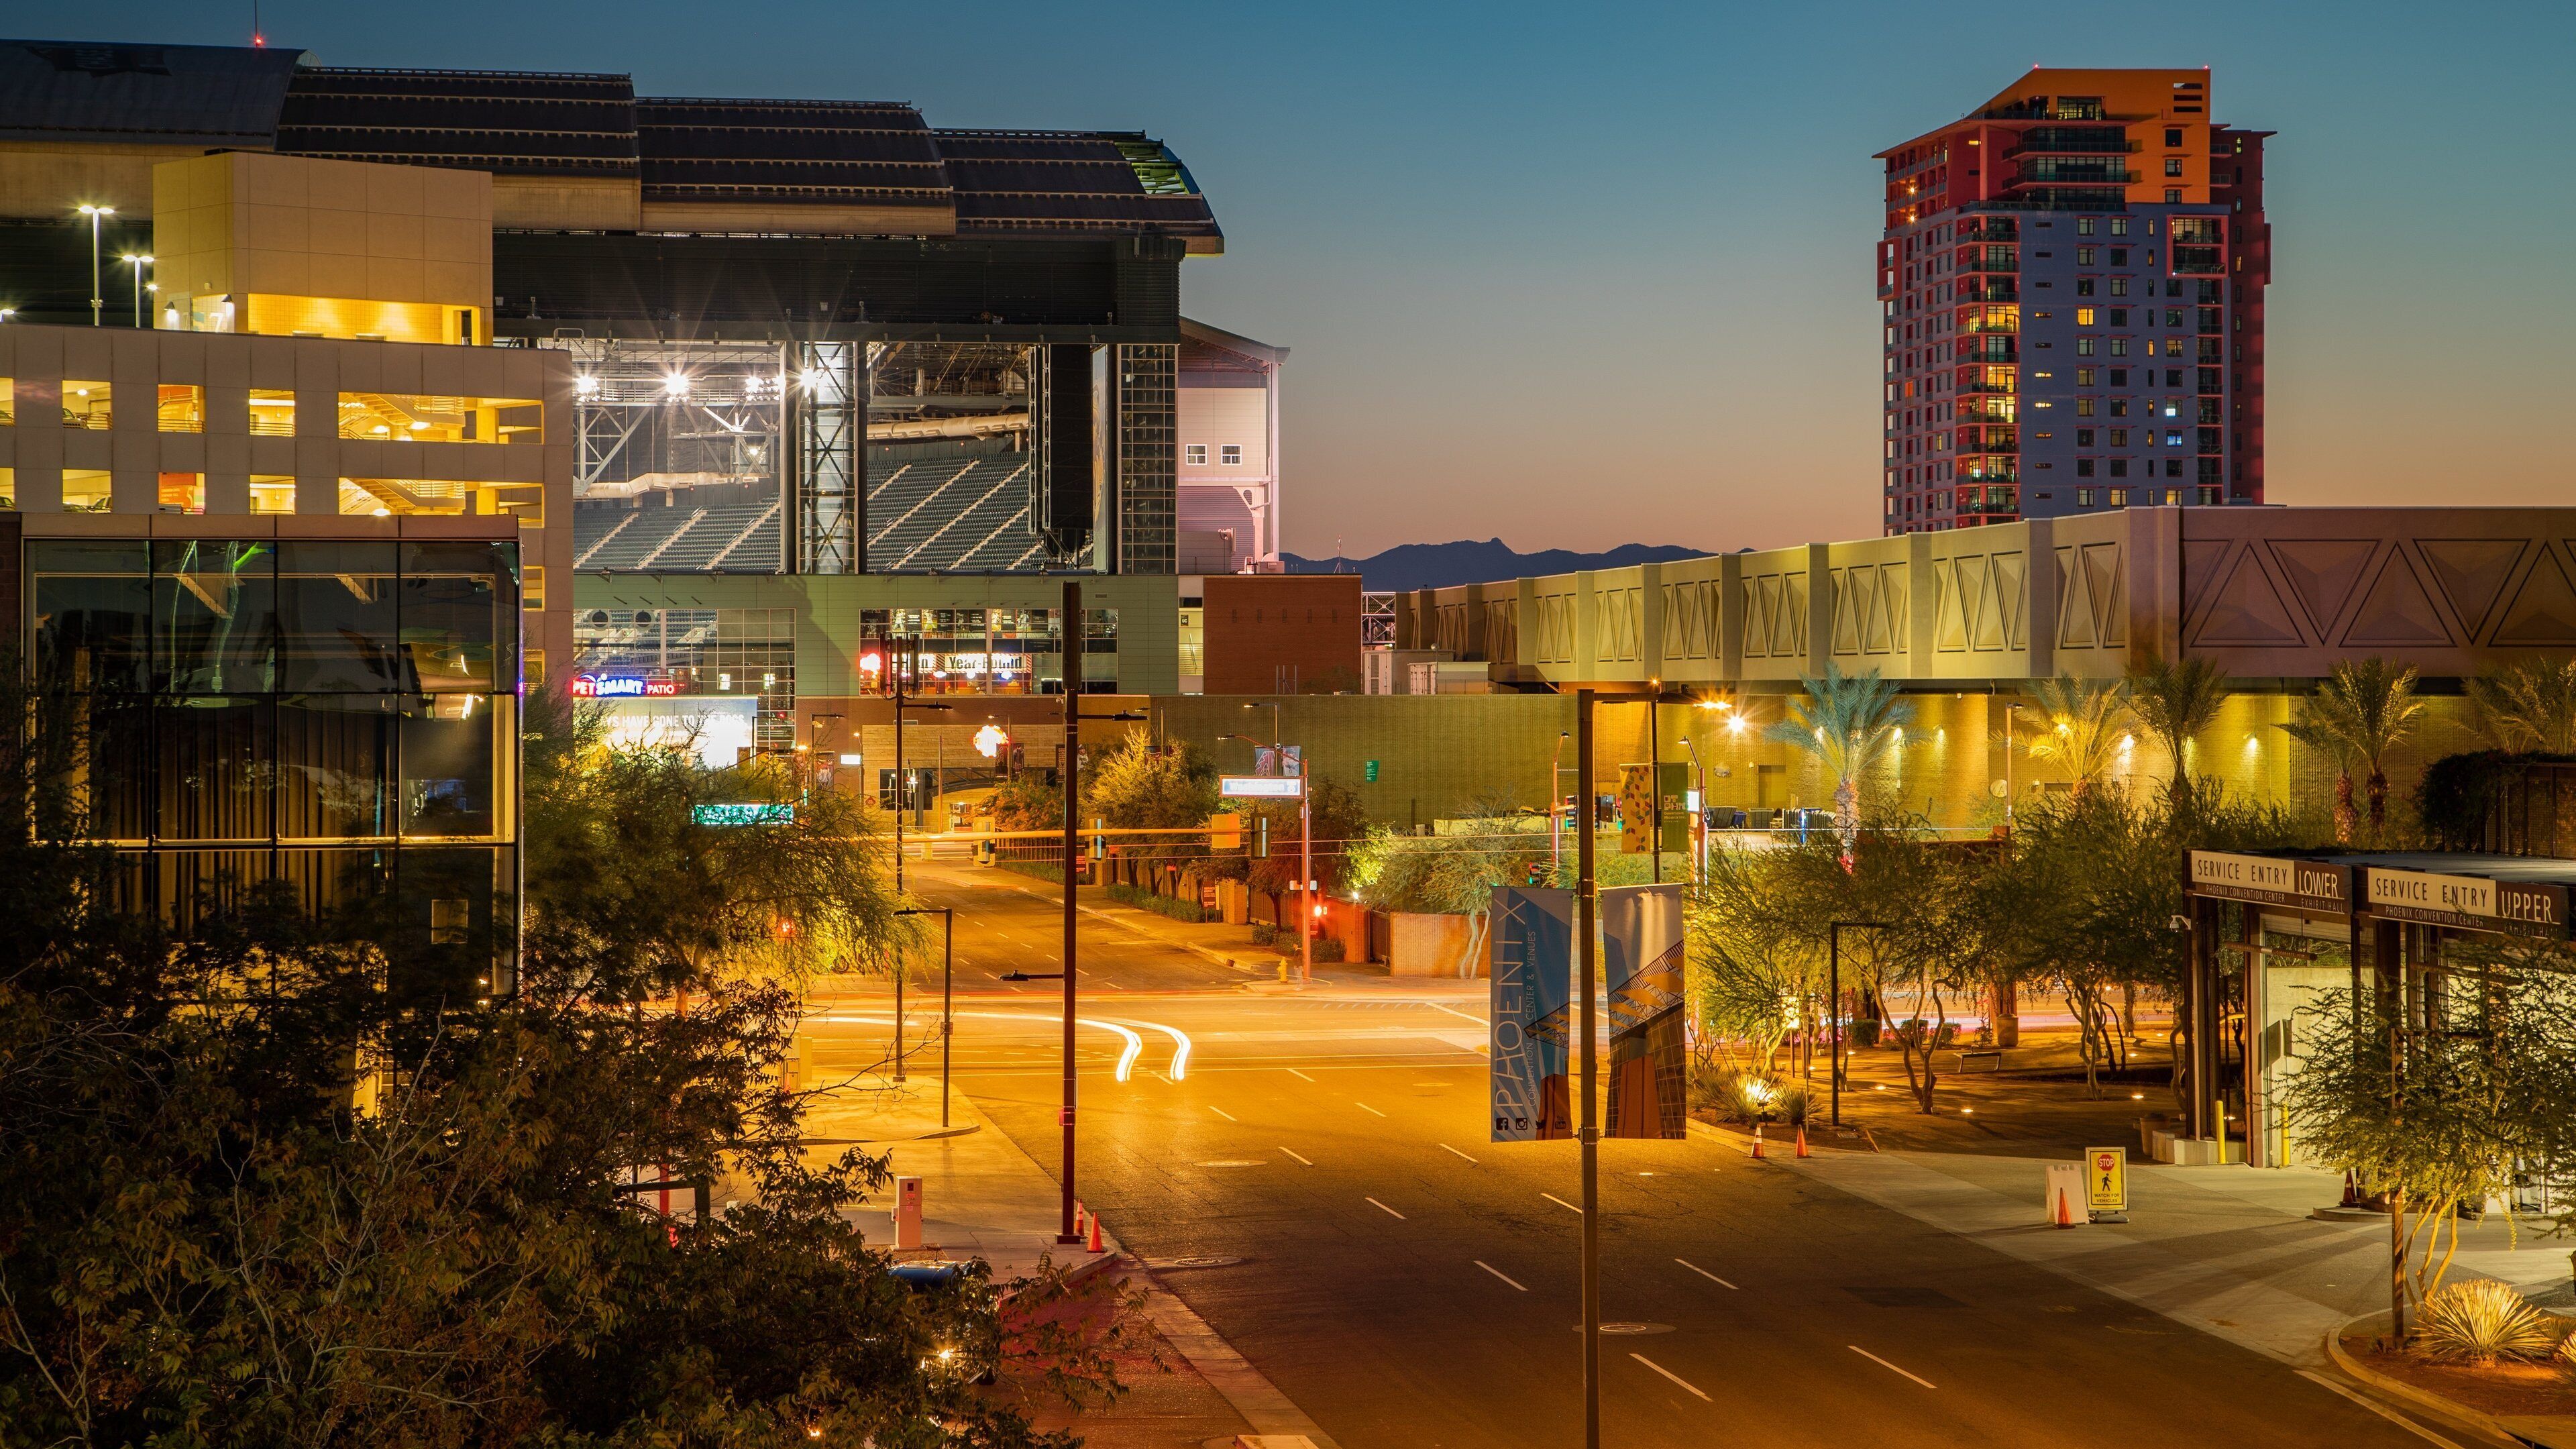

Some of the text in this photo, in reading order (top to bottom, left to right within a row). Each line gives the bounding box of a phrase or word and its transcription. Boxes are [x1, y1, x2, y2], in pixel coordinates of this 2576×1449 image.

[647, 684, 674, 694] PATIO
[622, 715, 649, 728] HAVE
[653, 715, 679, 728] GONE
[682, 714, 694, 727] TO
[2198, 859, 2339, 898] SERVICE ENTRY LOWER
[2206, 884, 2286, 903] PHOENIX CONVENTION CENTER
[2301, 898, 2344, 912] EXHIBIT HALL
[2376, 877, 2552, 922] SERVICE ENTRY UPPER
[2385, 906, 2413, 919] PHOENIX
[2415, 909, 2456, 924] CONVENTION
[1527, 931, 1536, 967] VENUES
[1492, 898, 1526, 1107] PHOENIX
[1525, 985, 1534, 1020] CENTER
[1526, 1042, 1536, 1107] CONVENTION
[2098, 1159, 2114, 1167] STOP
